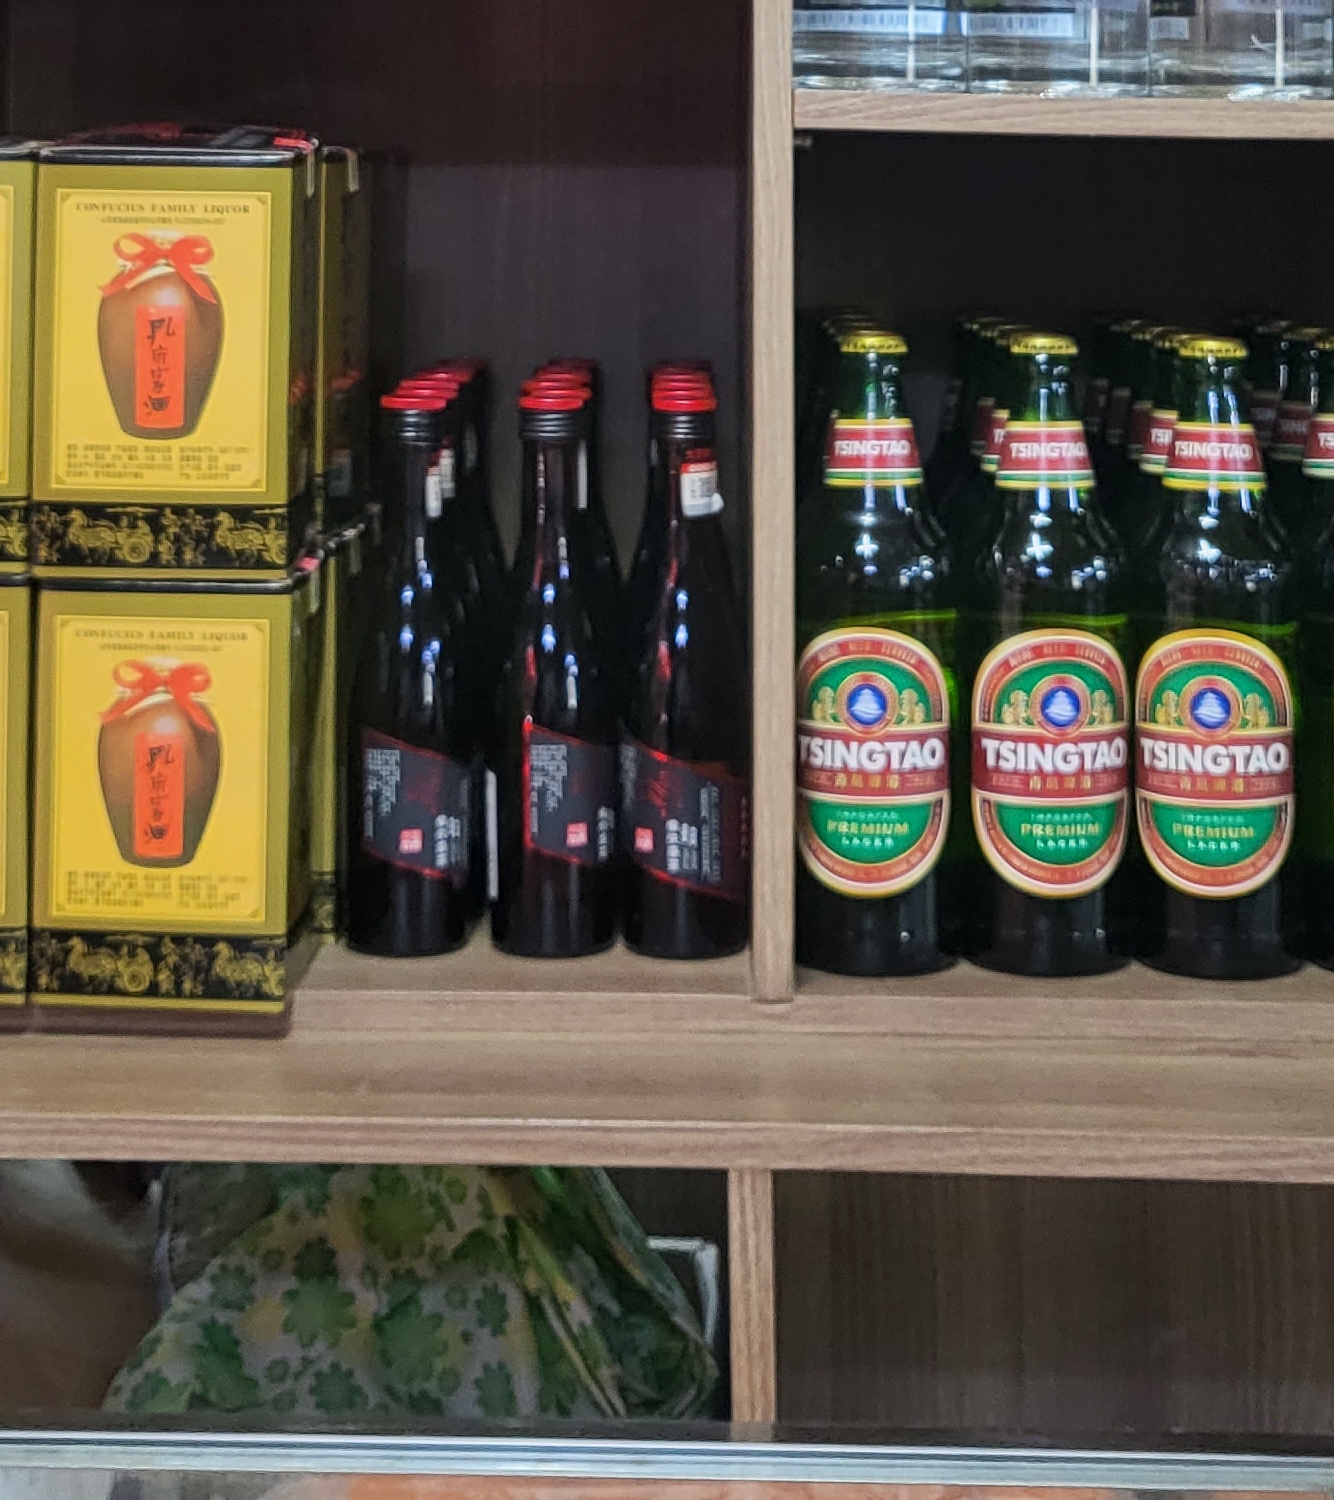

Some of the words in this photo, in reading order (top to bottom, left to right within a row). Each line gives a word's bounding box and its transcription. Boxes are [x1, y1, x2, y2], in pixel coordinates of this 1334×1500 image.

[75, 202, 146, 214] CONFUCIUS
[150, 203, 199, 215] FAMILY
[203, 204, 251, 216] LIQUOR
[833, 439, 910, 457] TSINGTAO
[1008, 441, 1087, 459] TSINGTAO
[1173, 440, 1253, 461] TSINGTAO
[75, 628, 145, 640] CONFUCIUS
[149, 629, 197, 641] FAMILY
[201, 630, 250, 642] LIQUOR
[798, 736, 945, 772] TSINGTAO
[980, 738, 1127, 774] TSINGTAO
[1139, 738, 1288, 776] TSINGTAO
[826, 820, 909, 836] PREMIUM
[1020, 821, 1099, 837] PREMIUM
[1172, 822, 1255, 840] PREMIUM
